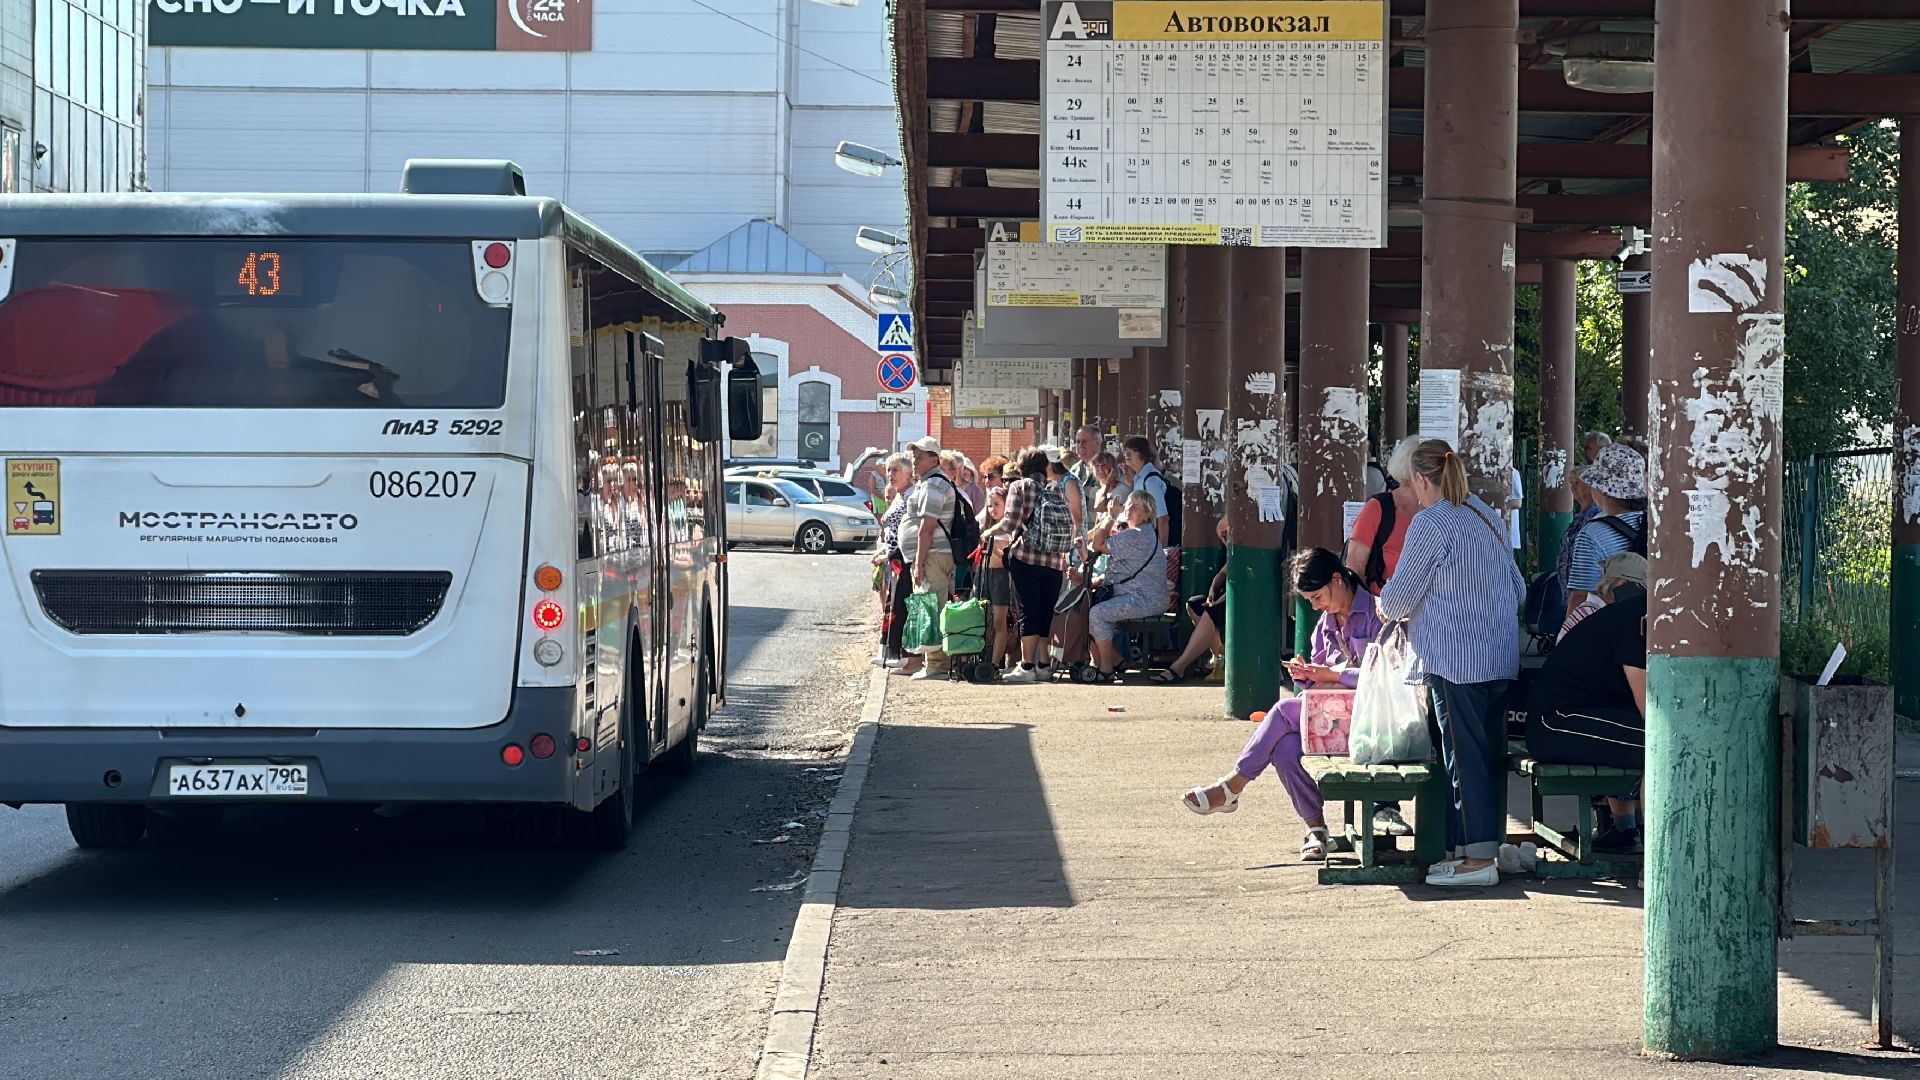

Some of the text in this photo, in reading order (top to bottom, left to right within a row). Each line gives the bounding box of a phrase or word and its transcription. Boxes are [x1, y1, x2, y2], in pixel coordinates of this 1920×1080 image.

[533, 12, 564, 21] ЧАСА
[1164, 10, 1331, 33] Автовокзал
[1067, 55, 1082, 67] 24
[1066, 98, 1082, 111] 29
[1127, 97, 1137, 105] 00
[1154, 97, 1163, 105] 35
[1066, 128, 1081, 141] 41
[1141, 127, 1150, 135] 33
[1221, 128, 1231, 136] 35
[1249, 128, 1257, 136] 50
[1289, 128, 1298, 136] 50
[1328, 128, 1337, 136] 20
[1062, 156, 1088, 168] 44к
[1208, 159, 1217, 167] 20
[1221, 159, 1231, 167] 45
[1261, 159, 1271, 167] 40
[1290, 159, 1298, 167] 10
[1370, 159, 1379, 167] 08
[1066, 198, 1082, 210] 44
[1208, 198, 1217, 206] 55
[1234, 198, 1244, 206] 40
[1248, 198, 1257, 206] 00
[1261, 198, 1271, 206] 05
[1274, 198, 1284, 206] 03
[1288, 198, 1298, 206] 25
[1301, 198, 1311, 206] 30
[1329, 198, 1338, 206] 15
[1342, 198, 1352, 206] 32
[238, 252, 281, 295] 43
[383, 420, 502, 435] ЛиАЗ 5292
[12, 463, 54, 471] УСТУПИТЕ
[369, 472, 476, 497] 086207
[119, 511, 358, 530] МОСТРАНСАВТО
[140, 535, 338, 544] РЕГУЛЯРНЫЕ МАРШРУТЫ ПОДМОСКОВЬЯ
[177, 770, 264, 791] А637АХ
